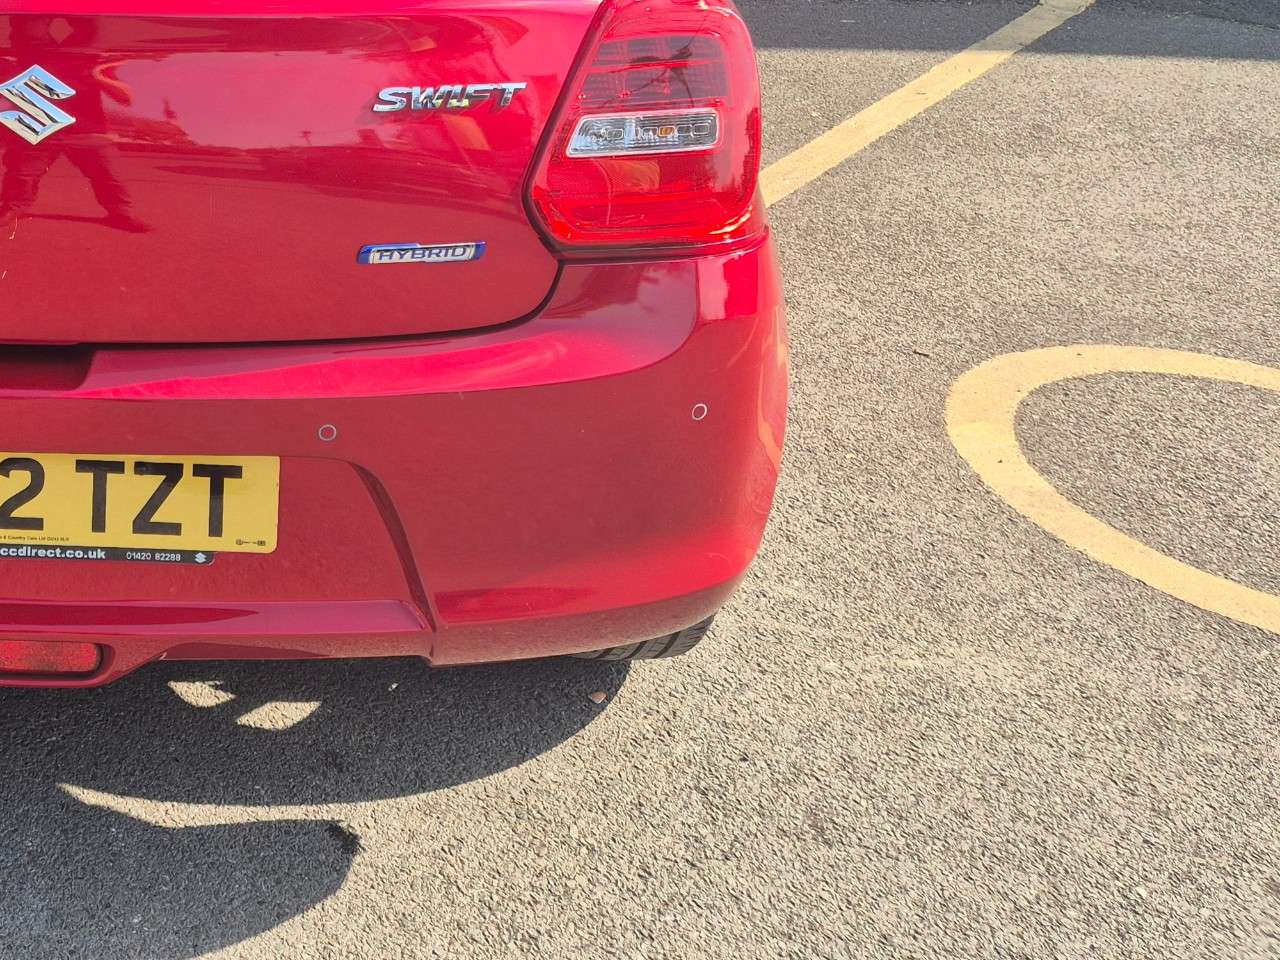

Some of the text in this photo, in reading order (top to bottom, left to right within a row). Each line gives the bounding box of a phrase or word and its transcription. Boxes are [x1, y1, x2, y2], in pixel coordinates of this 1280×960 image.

[373, 82, 527, 112] SWIFT
[377, 246, 469, 262] HYBRID
[75, 458, 243, 538] TZT
[126, 551, 152, 560] 01420
